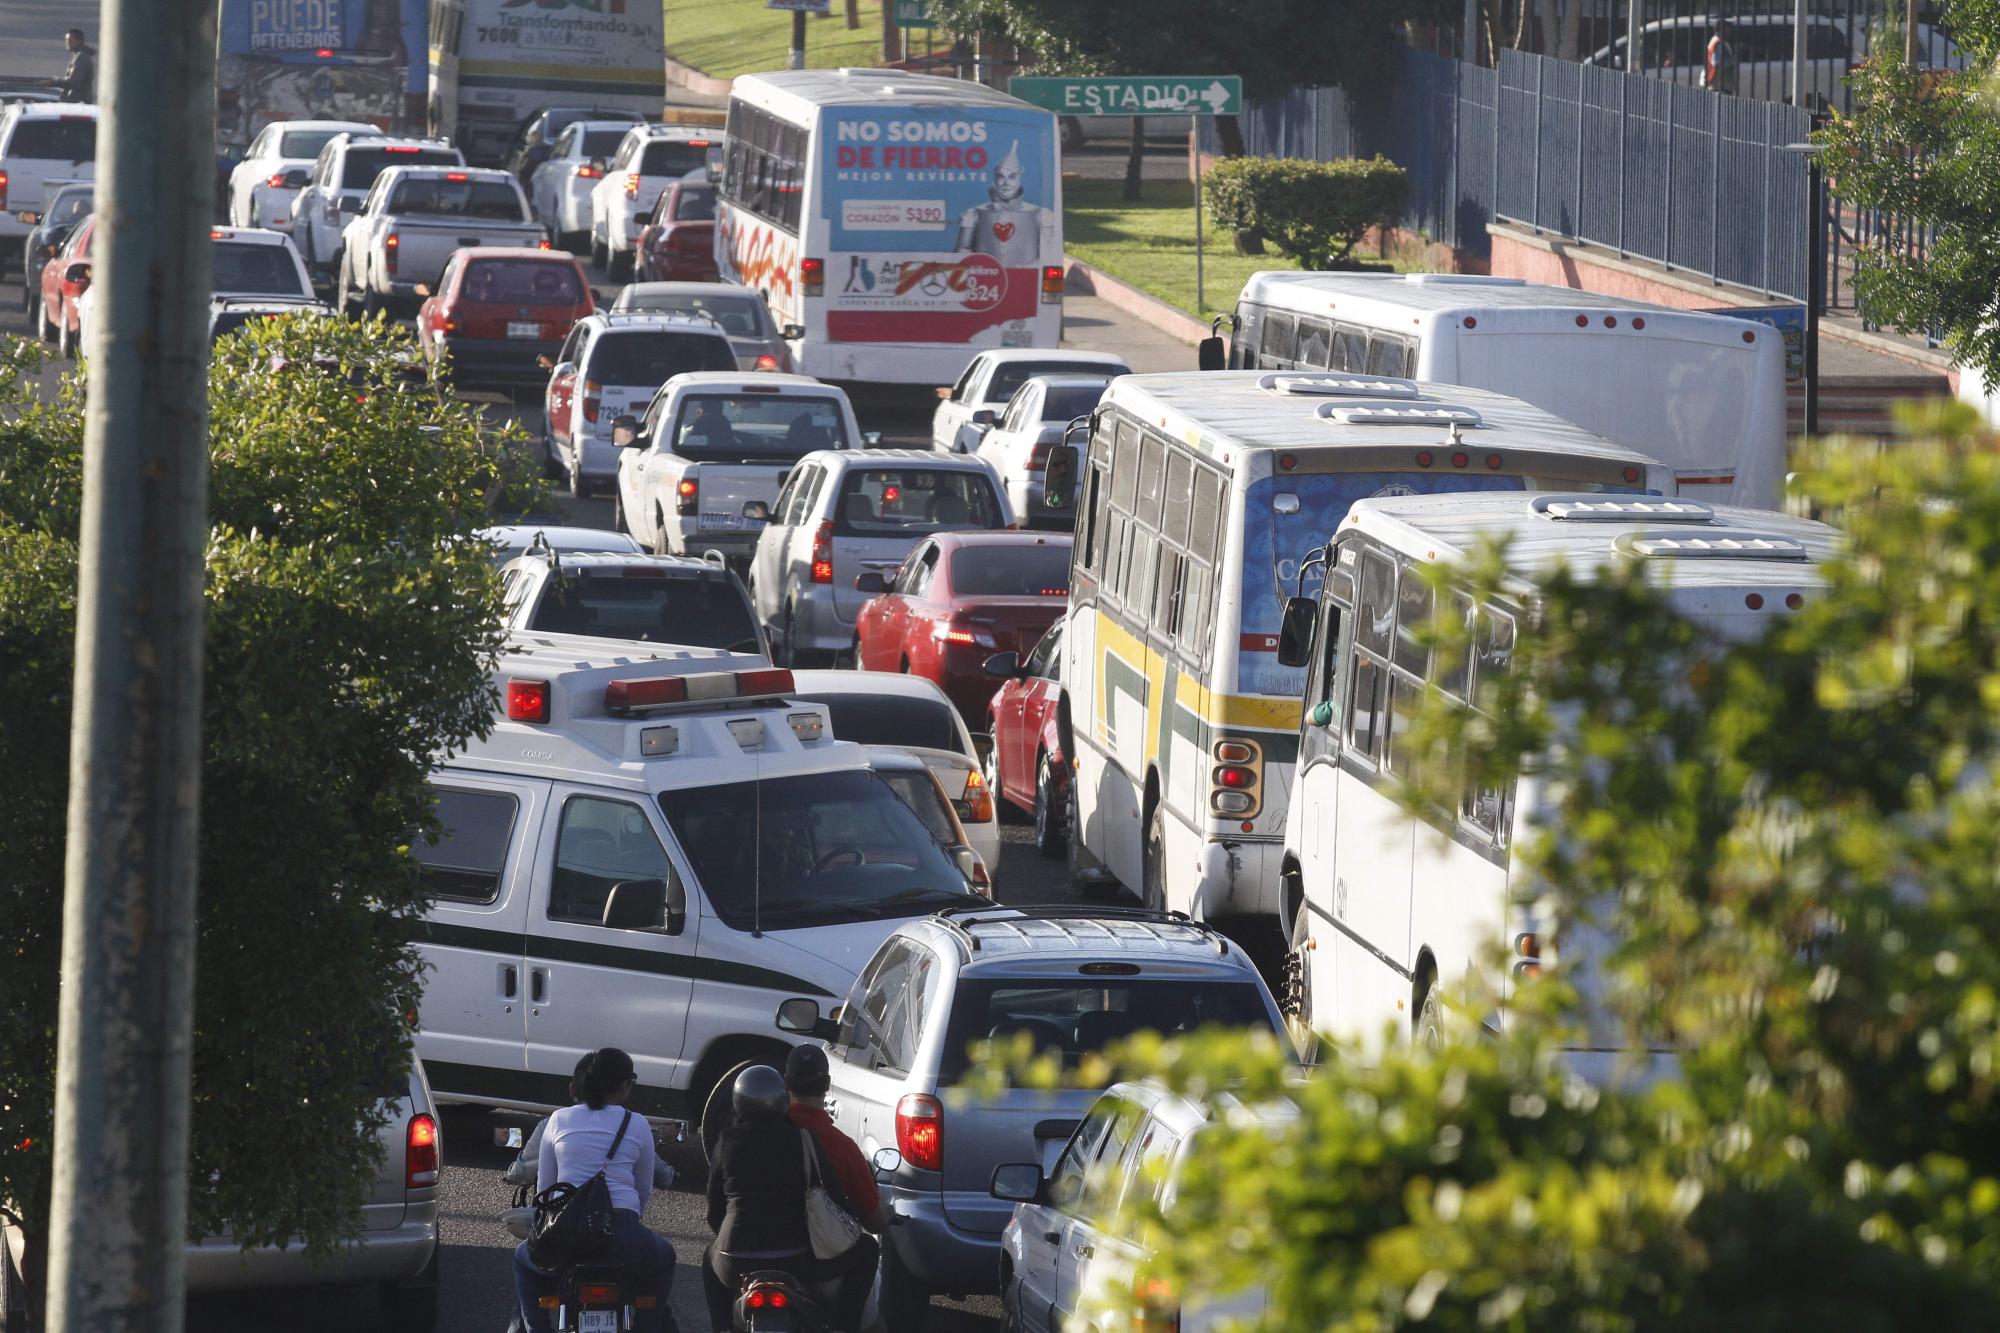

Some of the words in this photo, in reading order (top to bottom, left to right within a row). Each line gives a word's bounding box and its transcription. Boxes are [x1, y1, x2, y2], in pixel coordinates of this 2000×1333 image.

[250, 0, 340, 32] PUEDE
[498, 11, 628, 33] Transformando
[251, 31, 342, 49] DETENERNOS
[1064, 85, 1190, 107] ESTADIO
[837, 121, 880, 142] NO
[887, 121, 988, 142] SOMOS
[837, 146, 875, 168] DE
[883, 146, 988, 169] FIERRO
[837, 172, 893, 182] MEJOR
